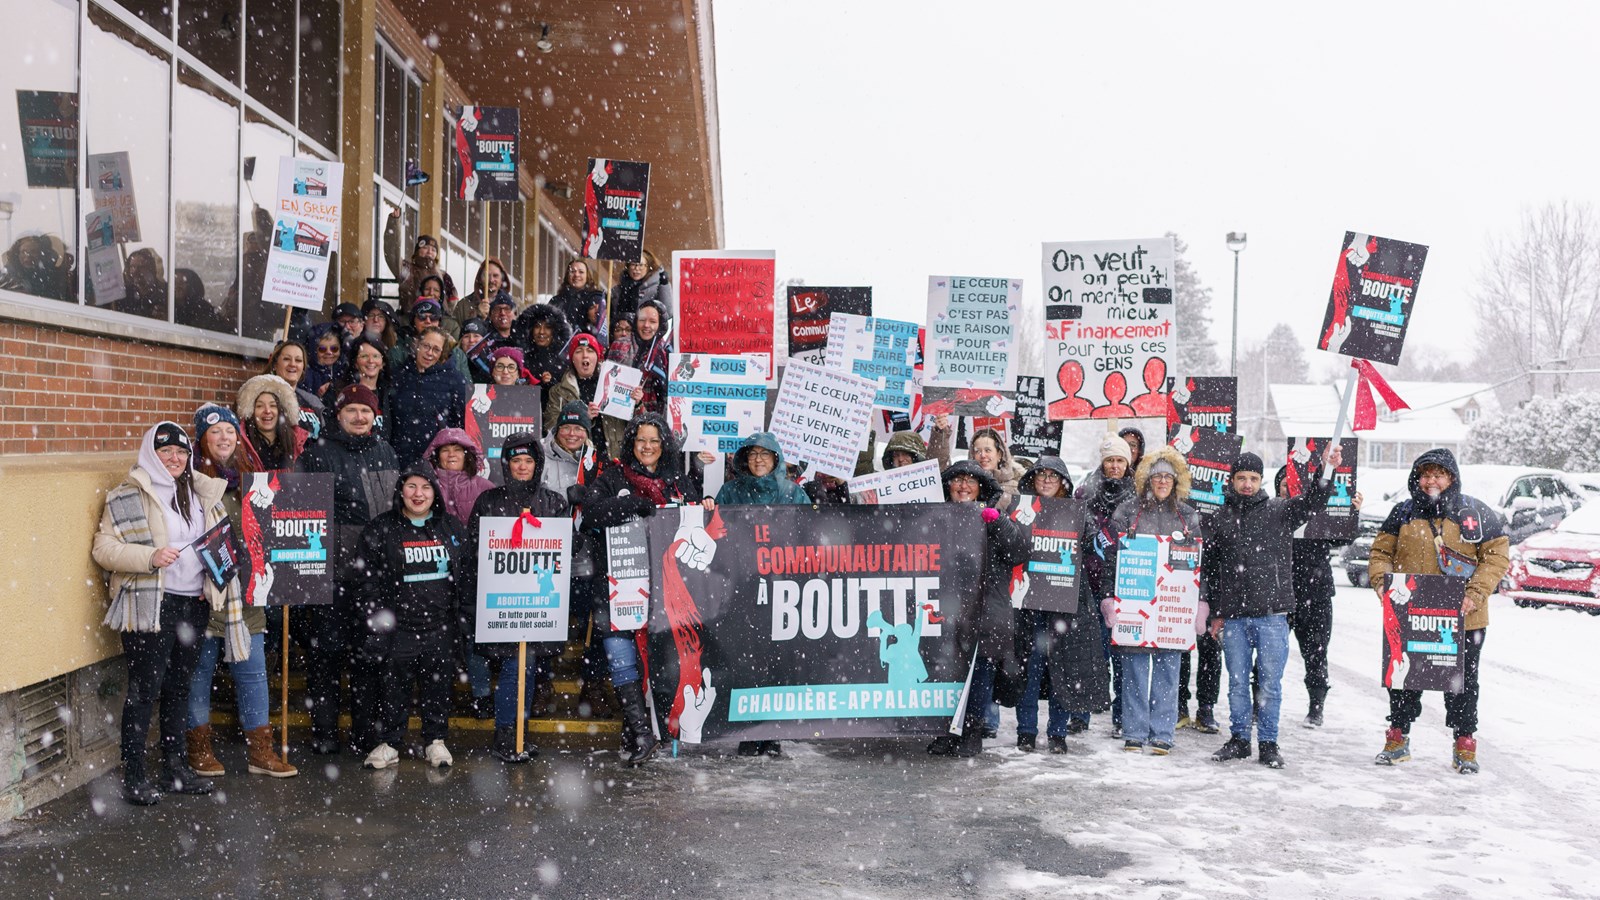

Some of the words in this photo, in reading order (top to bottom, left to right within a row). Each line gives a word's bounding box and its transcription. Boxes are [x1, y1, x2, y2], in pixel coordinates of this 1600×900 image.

[479, 141, 514, 154] BOUTTE
[281, 200, 298, 212] EN
[607, 196, 642, 211] BOUTTE
[298, 242, 320, 254] BOUTTE
[1052, 249, 1085, 271] On
[710, 262, 770, 278] conditions
[952, 279, 966, 289] LE
[969, 278, 1008, 289] CŒUR
[1083, 274, 1107, 285] on
[684, 280, 700, 295] de
[704, 280, 740, 295] travail
[1362, 279, 1413, 303] BOUTTE
[952, 294, 965, 303] LE
[968, 293, 1007, 303] CŒUR
[1048, 285, 1073, 302] On
[1081, 287, 1138, 305] mérite
[793, 295, 817, 313] Le
[986, 309, 1008, 320] PAS
[1108, 303, 1158, 320] mieux
[684, 316, 701, 333] les
[793, 324, 830, 337] commun
[876, 321, 918, 335] BOUTTE
[936, 324, 961, 334] UNE
[1061, 319, 1172, 340] Financement
[875, 336, 890, 345] DE
[895, 338, 908, 348] SE
[957, 338, 990, 349] POUR
[1058, 342, 1095, 357] Pour
[1102, 340, 1134, 355] tous
[1141, 341, 1167, 353] ces
[873, 350, 906, 363] TAIRE,
[938, 350, 1007, 362] TRAVAILLER
[711, 361, 746, 372] NOUS
[853, 361, 912, 378] ENSEMBLE
[938, 363, 946, 374] À
[950, 363, 995, 375] BOUTTE
[1001, 368, 1004, 377] !
[1094, 356, 1133, 372] GENS
[805, 381, 819, 393] LE
[821, 386, 859, 404] CŒUR
[1019, 377, 1039, 397] LE
[808, 400, 845, 420] PLEIN,
[791, 414, 804, 425] LE
[807, 418, 851, 439] VENTRE
[1192, 413, 1232, 427] BOUTTE
[492, 423, 534, 438] BOUTTE
[703, 422, 738, 433] NOUS
[1024, 424, 1038, 436] ET
[718, 440, 745, 450] BRIS
[803, 433, 830, 449] VIDE
[1013, 434, 1058, 449] SOLIDAIRE
[1189, 465, 1230, 485] BOUTTE
[879, 486, 892, 497] LE
[899, 476, 936, 492] CŒUR
[271, 520, 276, 528] À
[276, 519, 327, 537] BOUTTE
[610, 526, 619, 534] de
[621, 526, 630, 534] se
[755, 525, 771, 543] LE
[611, 546, 646, 556] Ensemble
[1034, 536, 1078, 554] BOUTTE
[278, 551, 320, 559] ABOUTTE.INFO
[756, 543, 941, 575] COMMUNAUTAIRE
[1172, 551, 1198, 561] BOUTTE
[488, 551, 493, 560] À
[494, 552, 562, 574] BOUTTE
[623, 558, 635, 566] est
[1140, 558, 1152, 566] pas
[613, 568, 649, 578] solidaires
[1119, 587, 1150, 597] ESSENTIEL
[1160, 584, 1168, 592] On
[1182, 585, 1186, 593] à
[497, 596, 550, 605] ABOUTTE.INFO
[1159, 595, 1181, 603] boutte
[617, 606, 644, 616] BOUTTE
[757, 577, 768, 605] À
[771, 576, 942, 641] BOUTTE
[499, 611, 506, 619] En
[508, 611, 523, 619] lutte
[525, 611, 539, 620] pour
[1158, 615, 1166, 623] On
[488, 621, 508, 629] SURVIE
[510, 621, 518, 629] du
[519, 620, 532, 629] filet
[555, 620, 557, 628] !
[1118, 625, 1142, 634] BOUTTE
[1157, 625, 1173, 633] faire
[1412, 616, 1458, 632] BOUTTE
[1157, 636, 1186, 645] entendre
